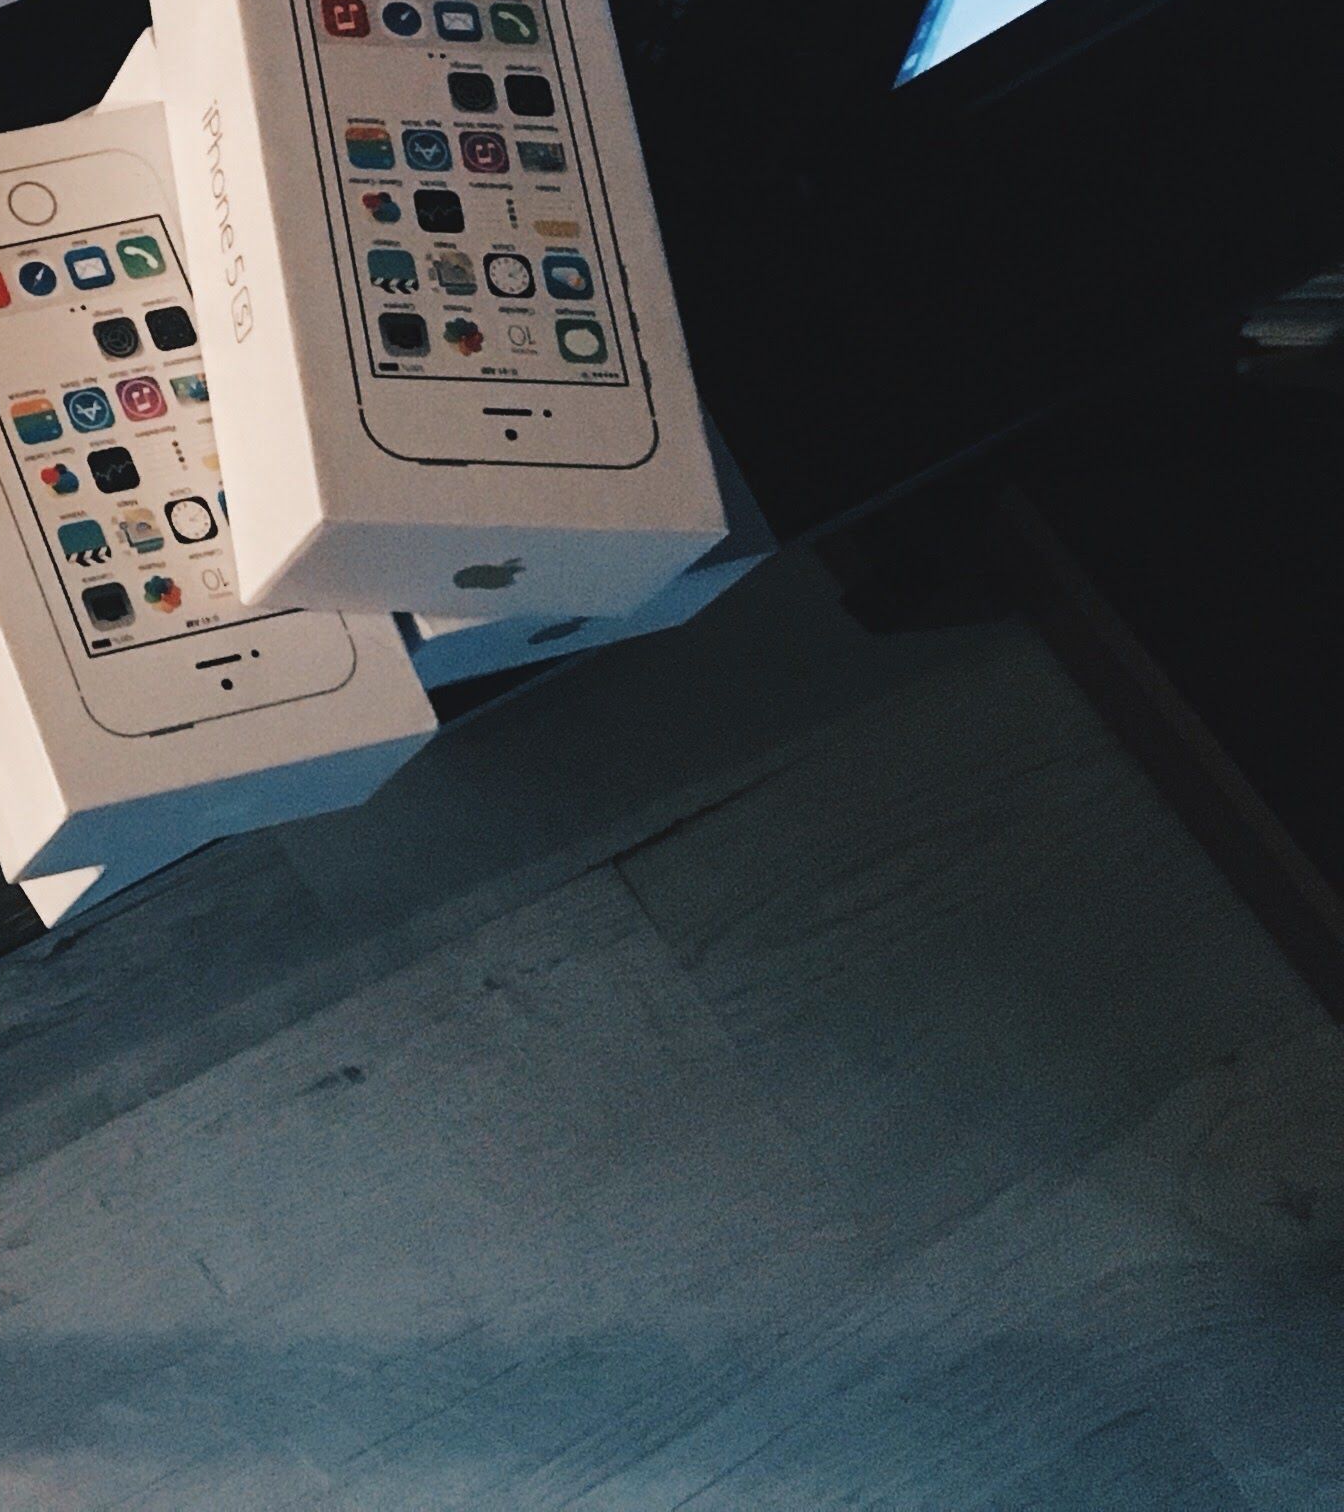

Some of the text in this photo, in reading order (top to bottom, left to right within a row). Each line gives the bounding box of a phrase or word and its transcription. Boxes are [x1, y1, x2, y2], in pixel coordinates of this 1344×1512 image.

[202, 99, 234, 254] iPhone
[508, 325, 536, 346] 10
[202, 568, 229, 590] 10
